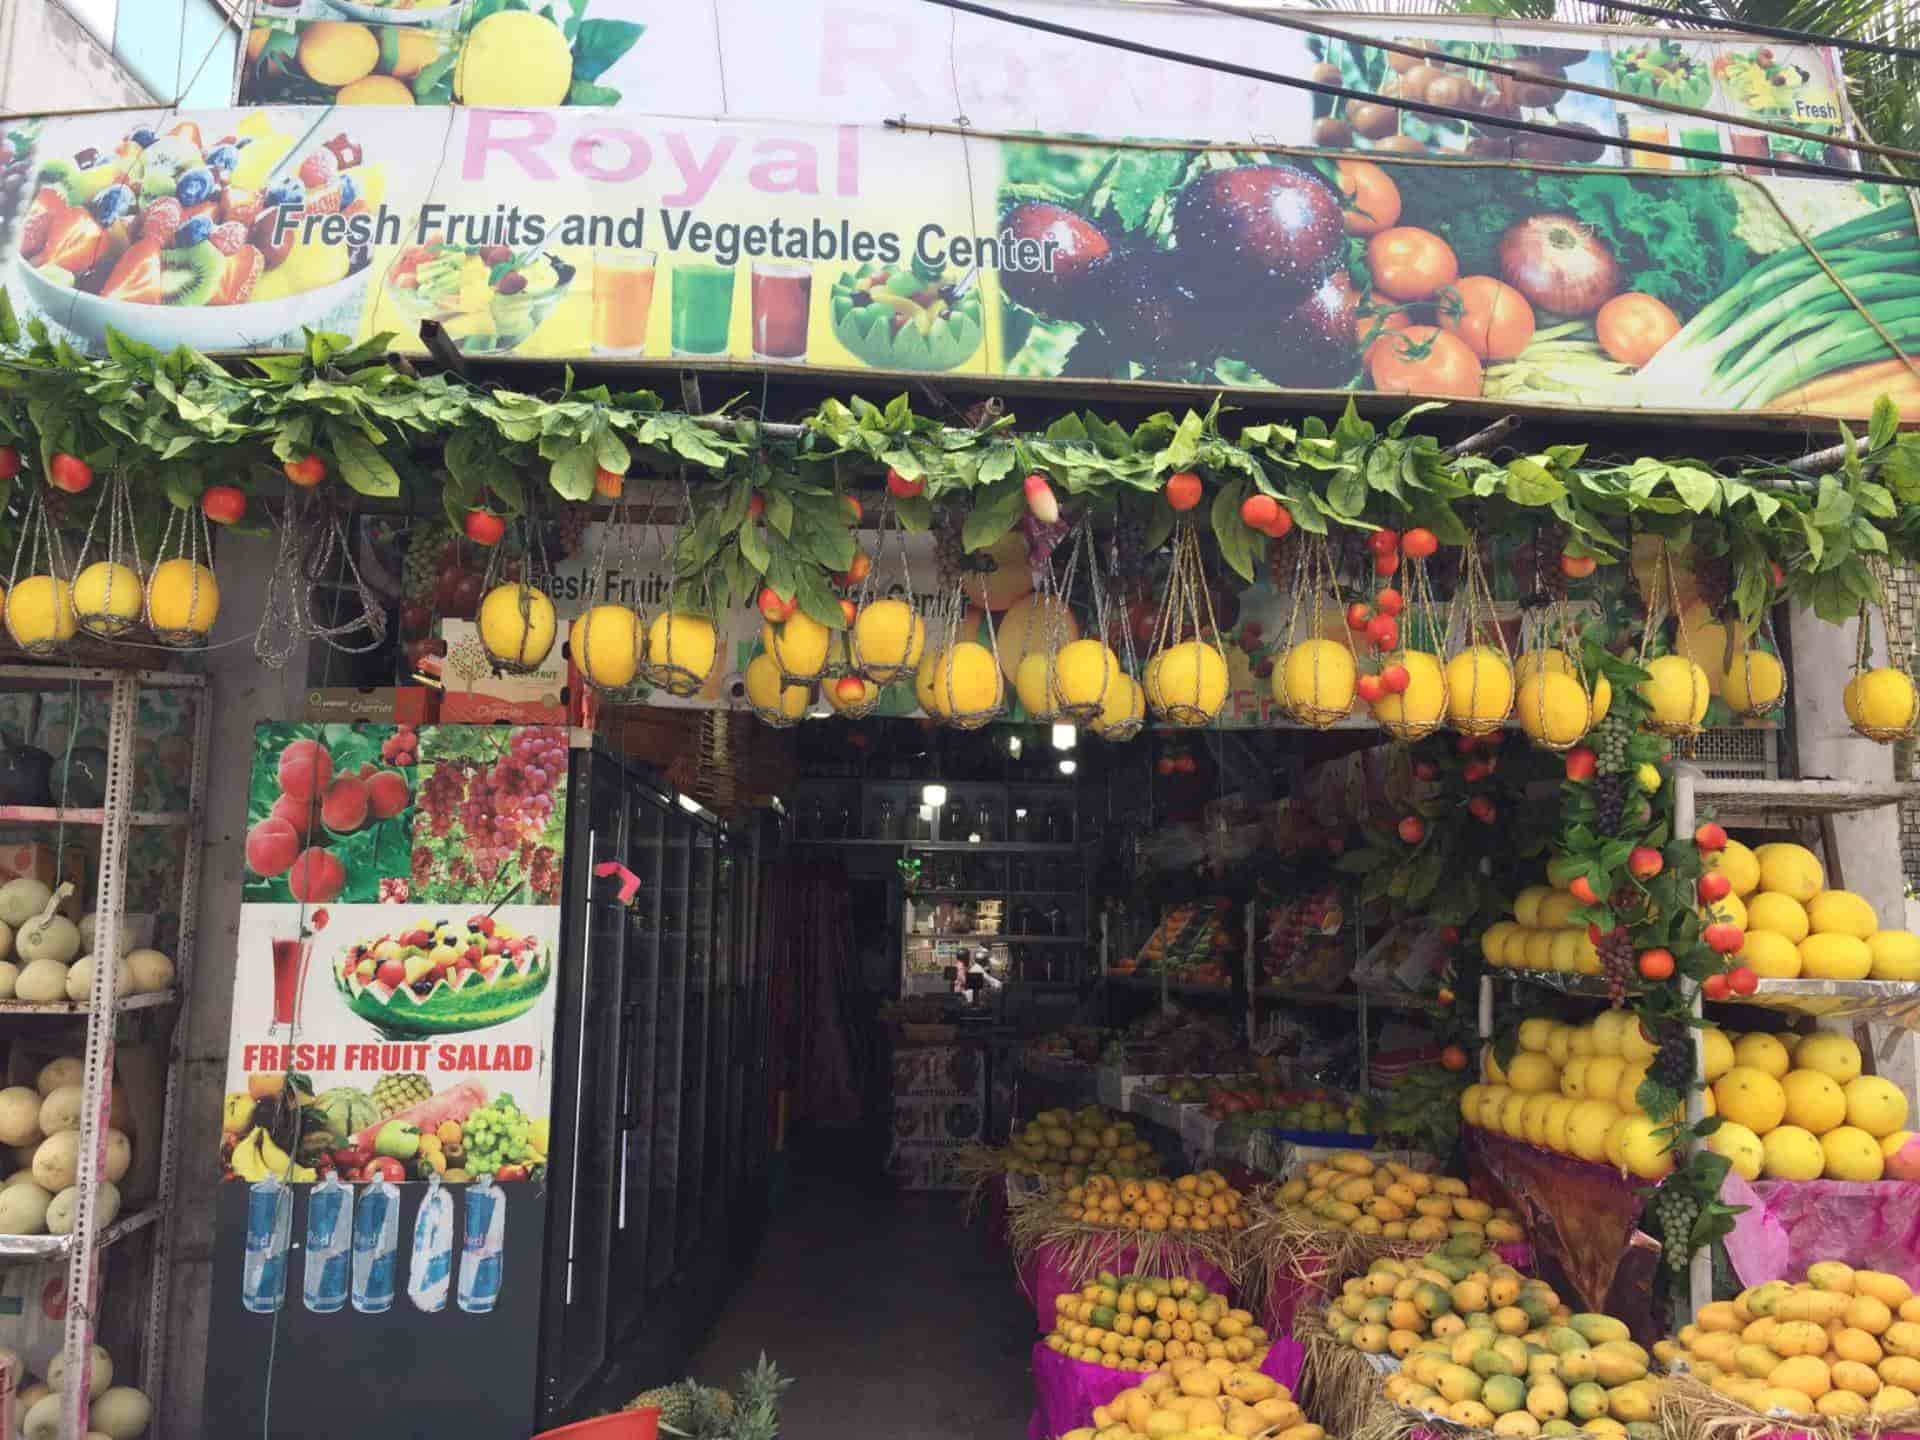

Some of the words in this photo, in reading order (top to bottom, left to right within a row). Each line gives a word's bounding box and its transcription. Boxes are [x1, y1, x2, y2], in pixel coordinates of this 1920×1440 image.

[1795, 99, 1837, 118] Fresh
[461, 108, 860, 208] Royal
[272, 204, 402, 246] Fresh
[416, 203, 547, 248] Fruits
[561, 207, 645, 249] and
[660, 208, 901, 266] Vegetables
[917, 223, 1059, 272] Center
[243, 1044, 337, 1071] FRESH
[344, 1044, 431, 1071] FRUIT
[438, 1045, 533, 1071] SALAD
